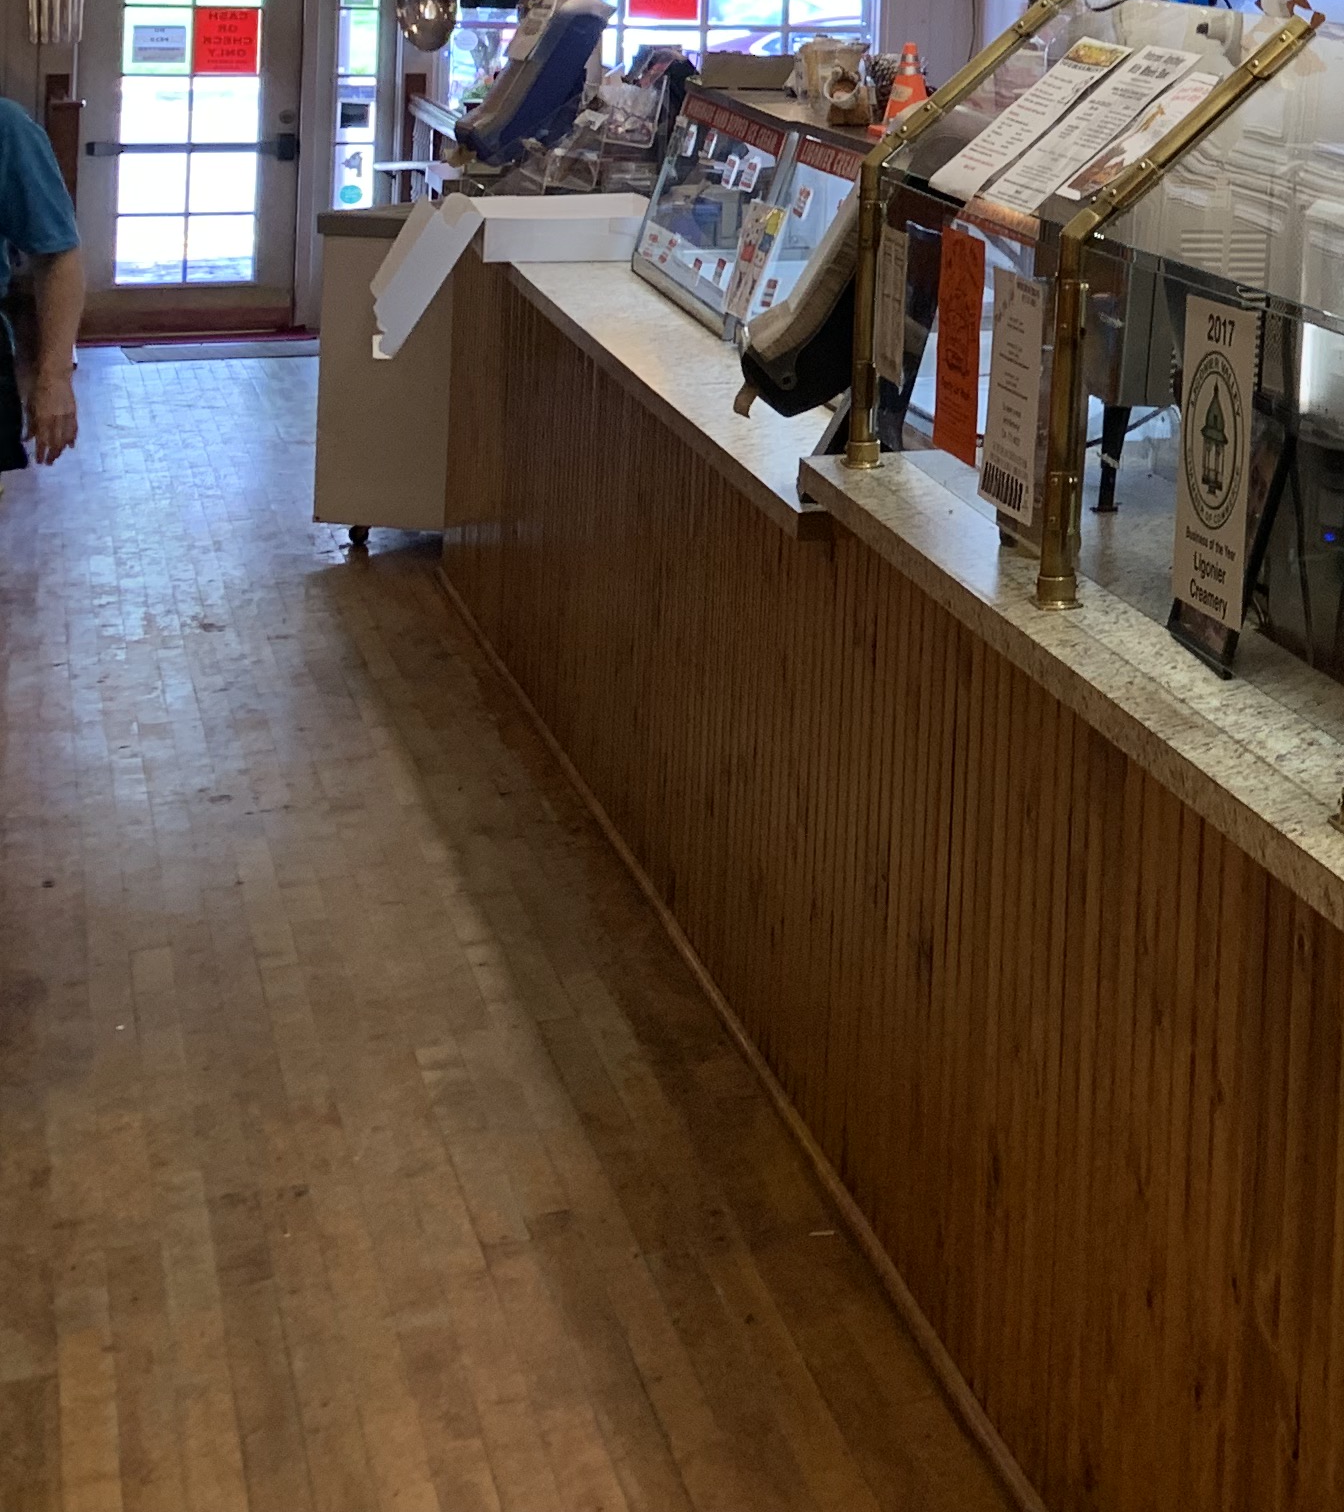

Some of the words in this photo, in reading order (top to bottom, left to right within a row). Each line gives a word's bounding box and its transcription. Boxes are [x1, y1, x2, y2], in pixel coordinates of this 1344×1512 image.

[1207, 313, 1235, 347] 2017
[1193, 551, 1226, 585] Ligonier
[1190, 578, 1228, 621] Creamery
